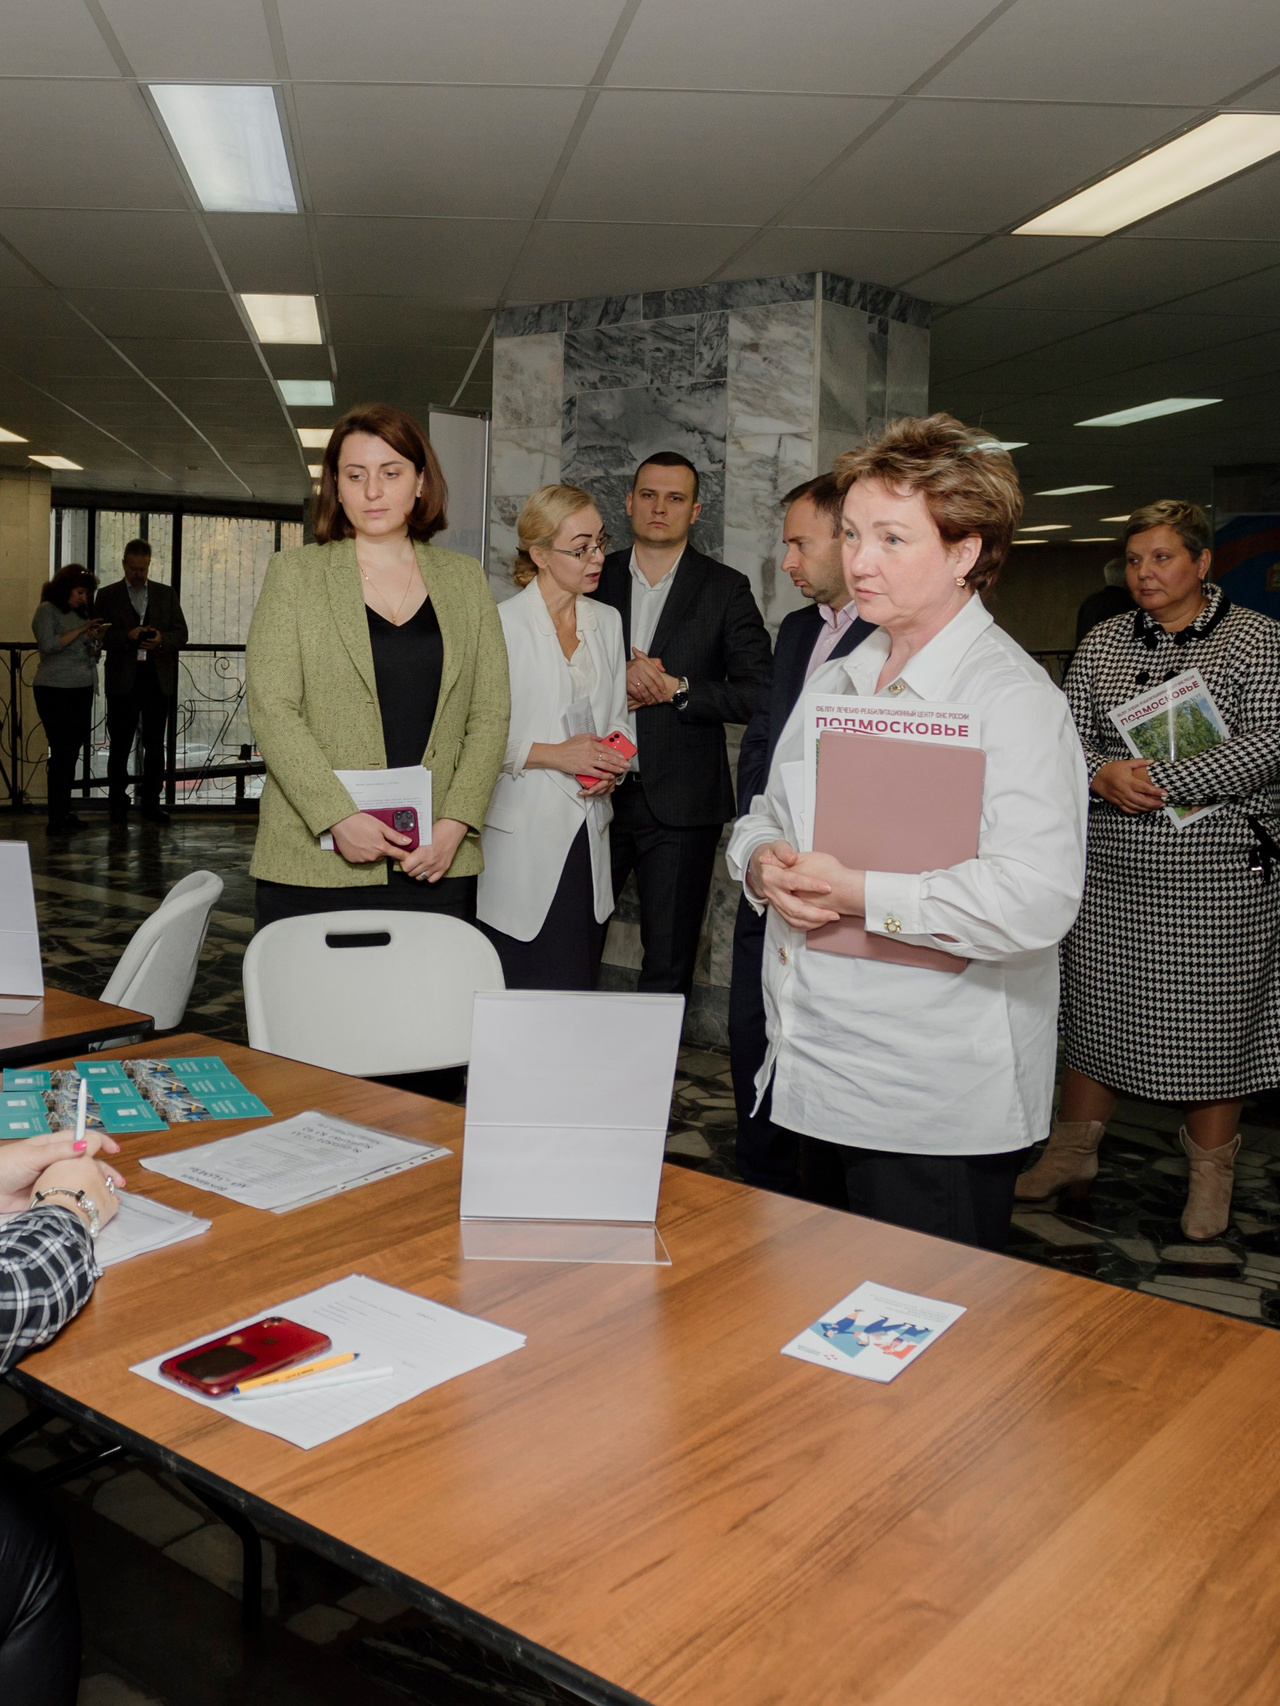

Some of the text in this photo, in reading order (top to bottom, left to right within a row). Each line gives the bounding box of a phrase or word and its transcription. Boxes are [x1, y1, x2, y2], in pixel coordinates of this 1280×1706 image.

[836, 706, 917, 718] ЛЕЧЕБНО-РЕАБИЛИТАЦИОННЫЙ
[917, 711, 934, 719] ЦЕНТР
[935, 711, 948, 720] ФНС
[948, 712, 970, 721] РОССИИ
[816, 717, 969, 737] ПОДМОСКОВЬЕ
